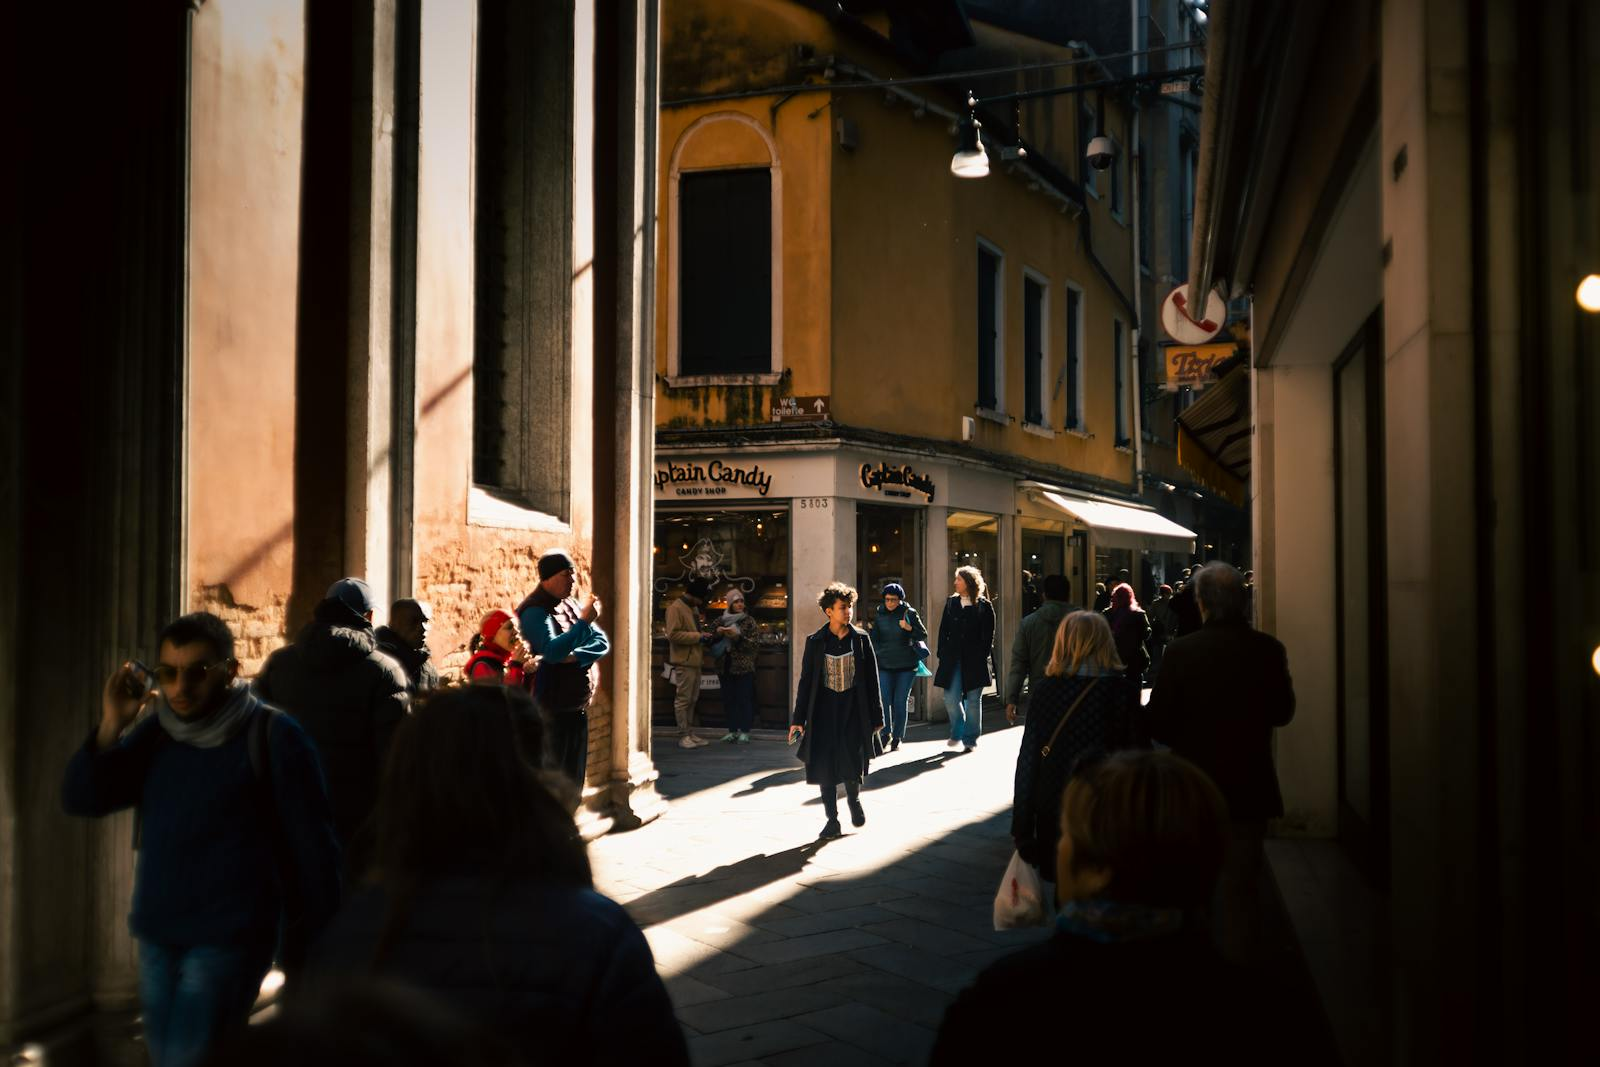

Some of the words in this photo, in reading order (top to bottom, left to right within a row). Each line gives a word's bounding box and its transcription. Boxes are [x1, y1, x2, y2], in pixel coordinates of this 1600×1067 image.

[655, 461, 707, 491] ptain
[708, 460, 772, 496] Candy
[676, 487, 703, 496] CANDY
[705, 486, 727, 495] SHOP
[800, 498, 829, 509] 5803
